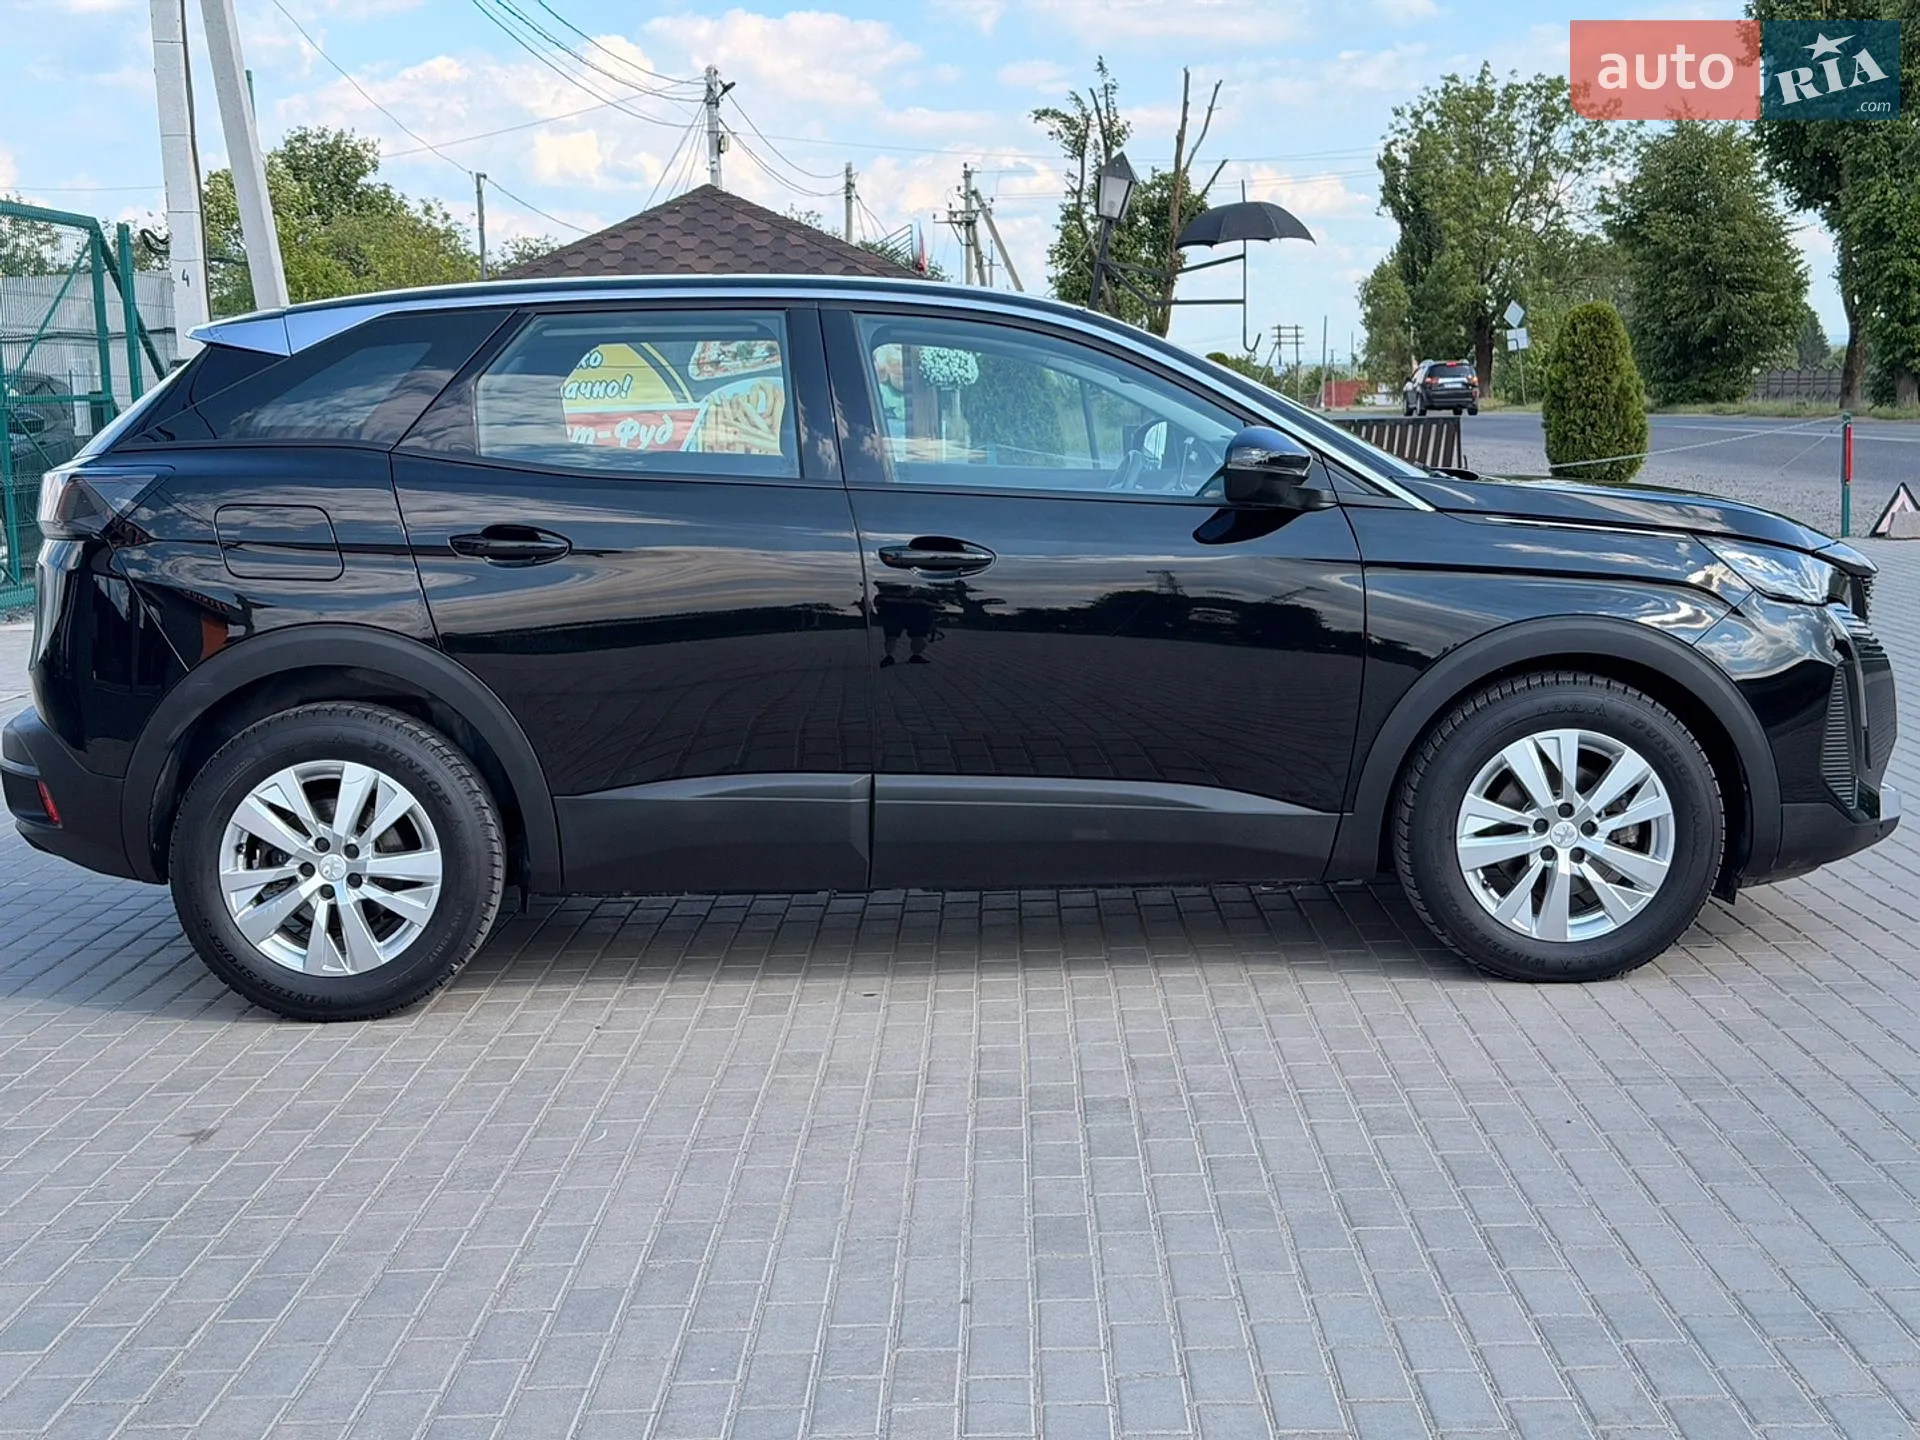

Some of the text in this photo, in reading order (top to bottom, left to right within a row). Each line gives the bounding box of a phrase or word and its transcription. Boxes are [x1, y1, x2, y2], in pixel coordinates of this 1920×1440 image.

[181, 268, 190, 288] 4
[560, 373, 633, 400] ачно!
[566, 413, 675, 450] т-Фуд
[371, 741, 453, 807] DUNLOP
